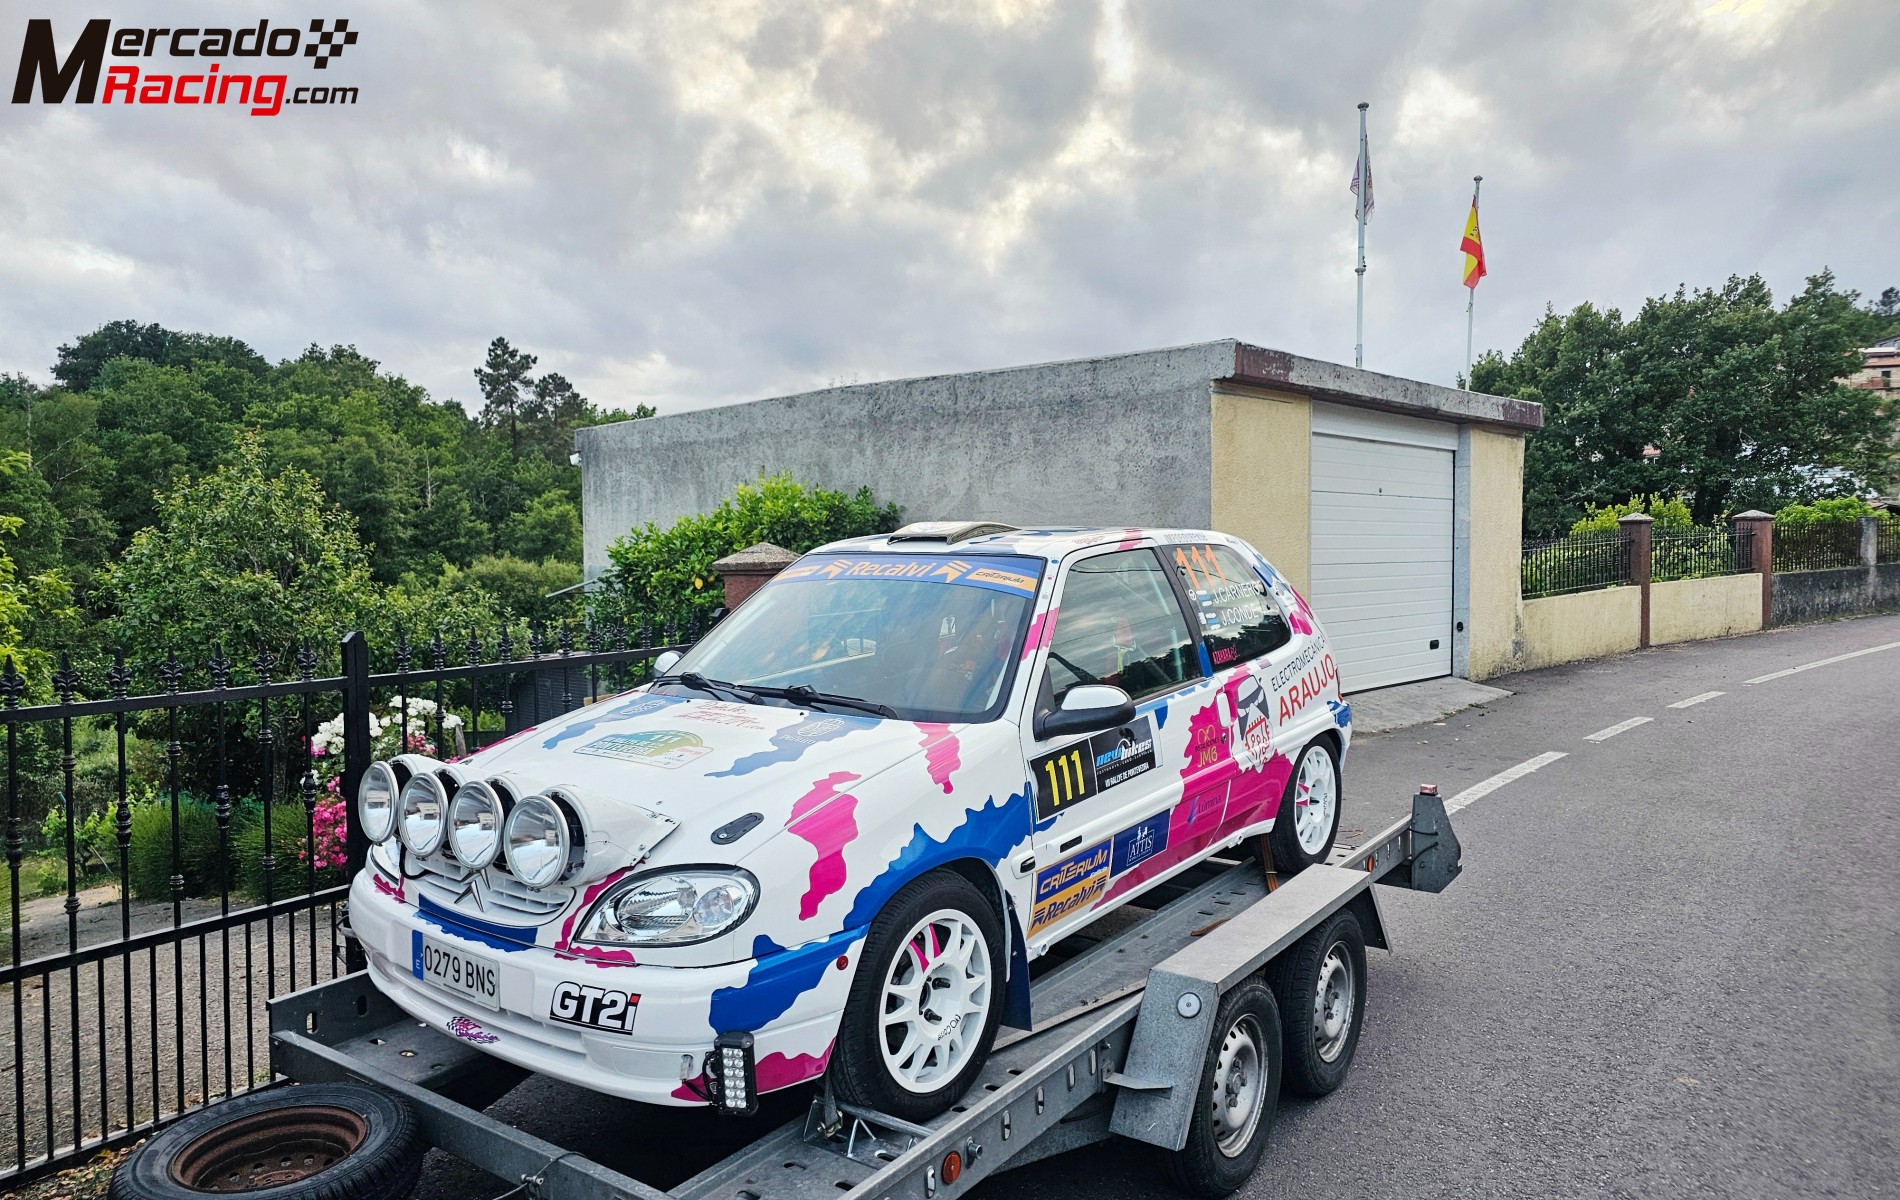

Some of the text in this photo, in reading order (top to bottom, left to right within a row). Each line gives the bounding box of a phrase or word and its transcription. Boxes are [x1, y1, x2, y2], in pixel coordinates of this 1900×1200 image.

[845, 561, 936, 578] Recalvi
[1175, 545, 1227, 590] 111
[1221, 604, 1259, 626] J.CONDE
[1279, 653, 1335, 727] ARAUJO
[1044, 749, 1086, 807] 111
[1197, 745, 1218, 768] JMB
[1129, 834, 1153, 859] ATTIS
[1042, 880, 1097, 924] Recalvi
[424, 944, 496, 997] 0279 BNS
[550, 980, 642, 1032] GT2i
